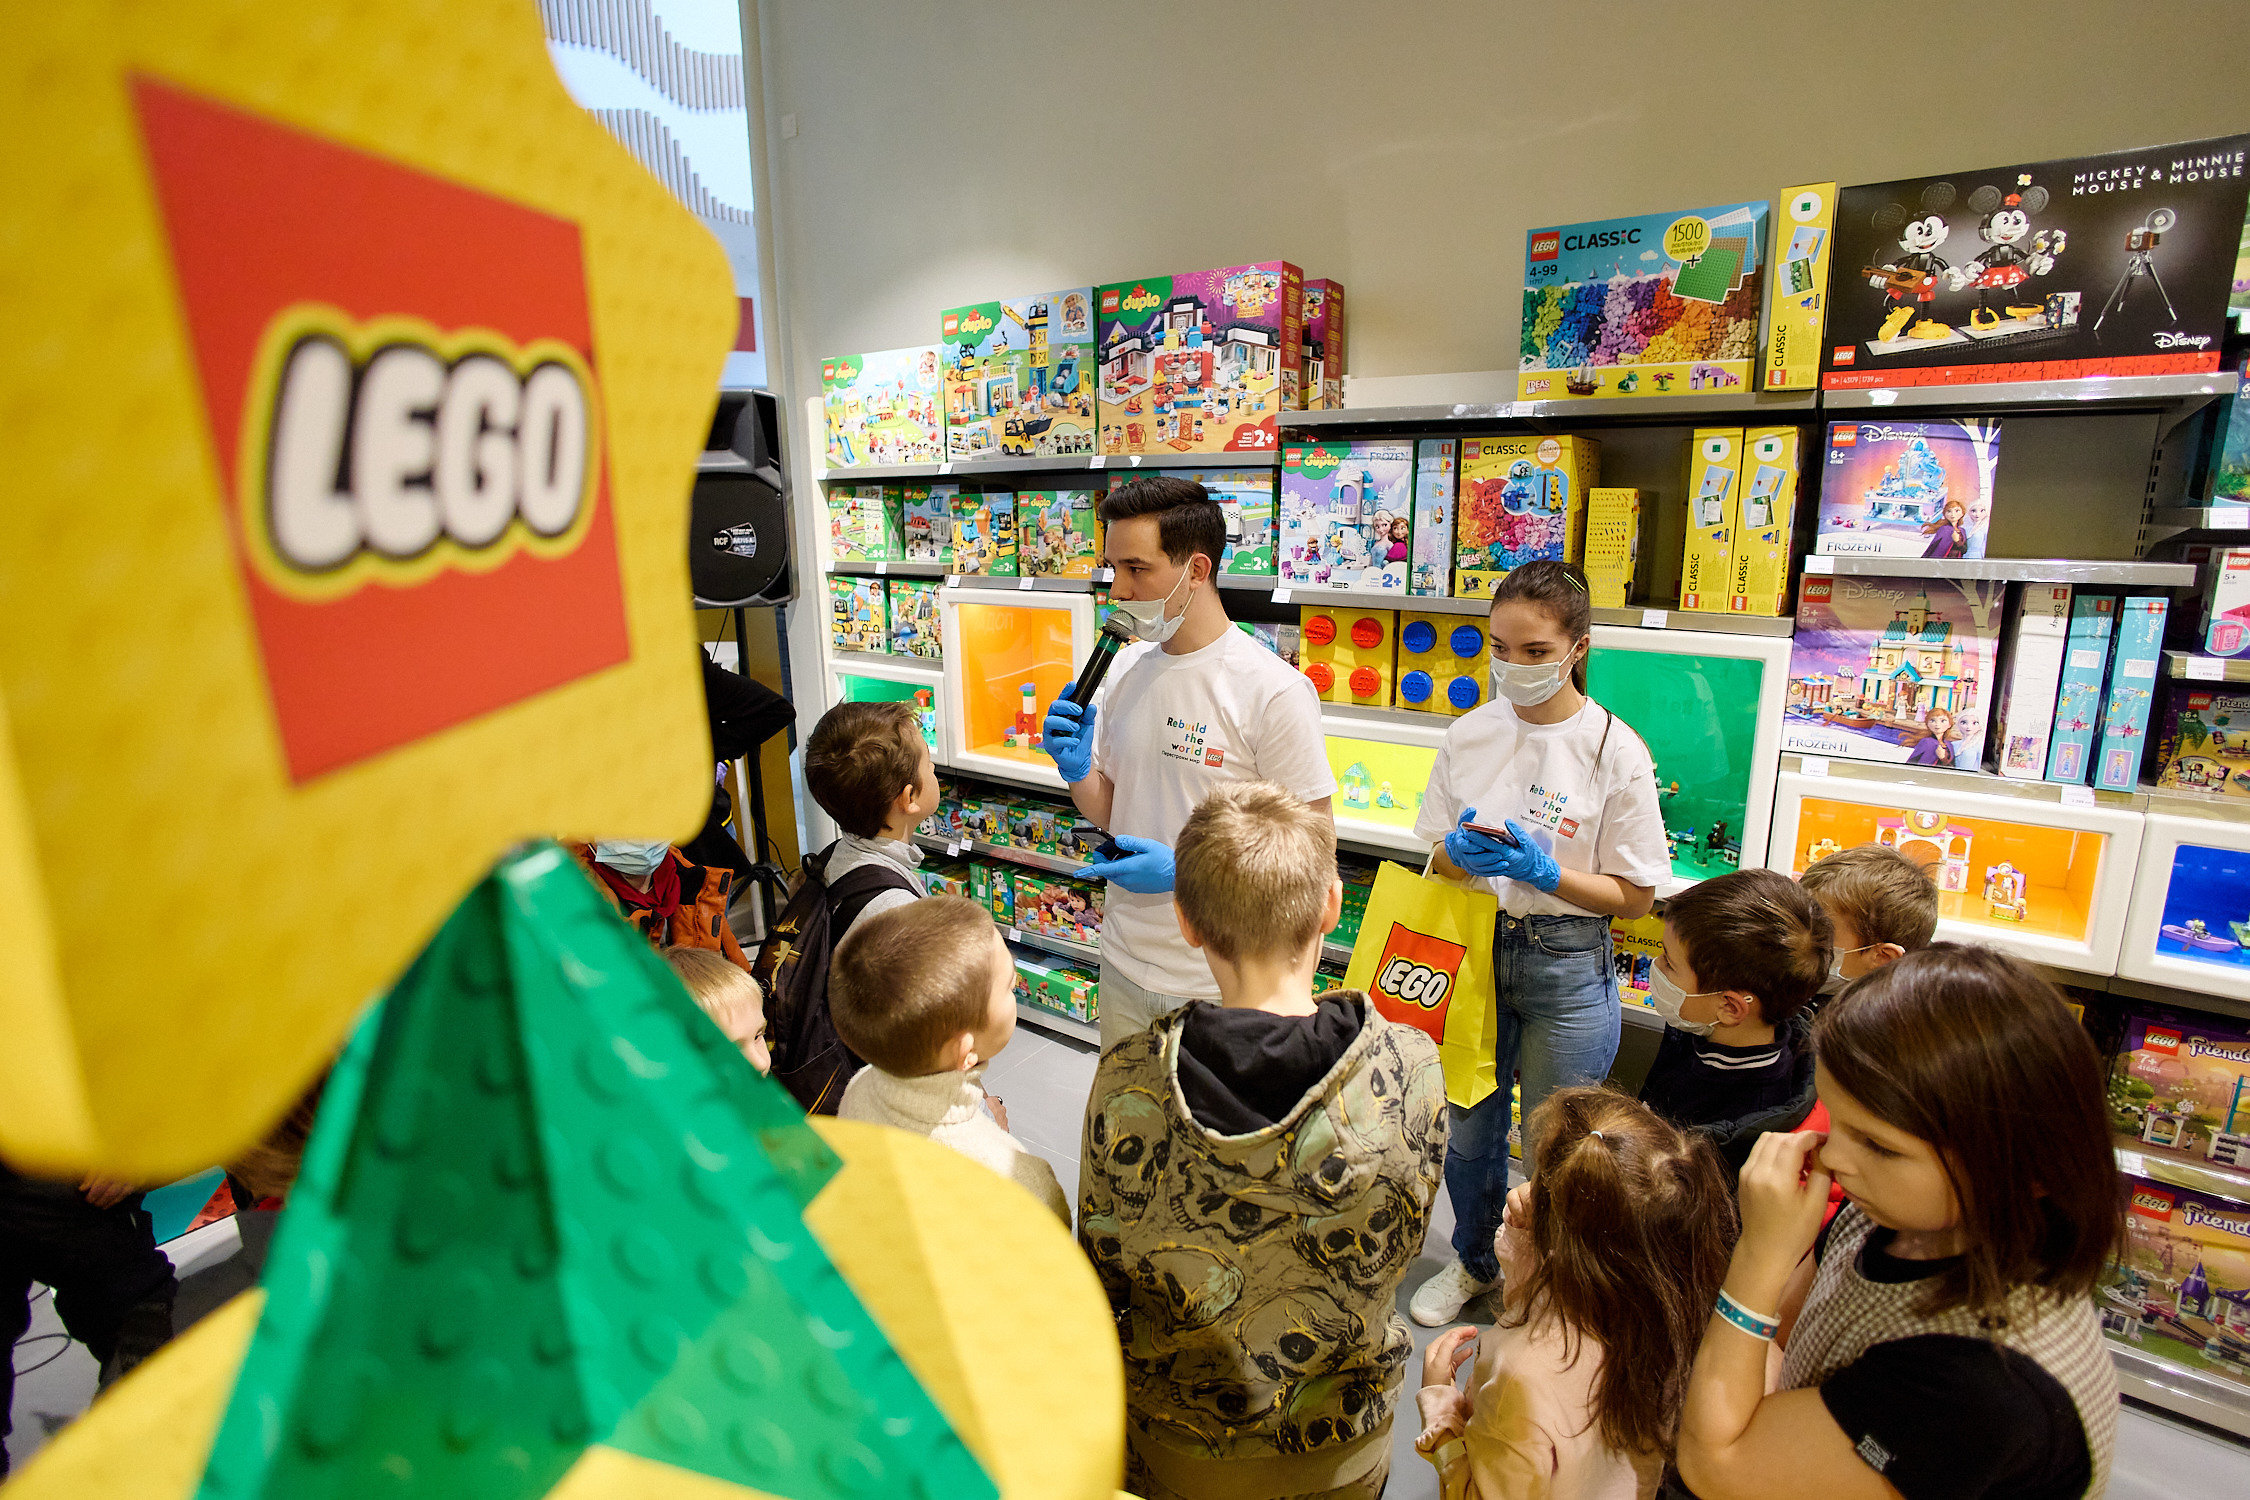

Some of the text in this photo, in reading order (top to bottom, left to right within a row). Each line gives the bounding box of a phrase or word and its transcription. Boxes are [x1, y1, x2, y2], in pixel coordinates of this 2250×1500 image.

[2074, 152, 2245, 184] MICKEY & MINNIE
[2072, 165, 2243, 196] MOUSE MOUSE
[1672, 221, 1704, 242] 1500
[1533, 228, 1642, 252] LEGO CLASSIC
[1529, 264, 1558, 277] 4-99
[1102, 291, 1161, 312] LEGO duplo
[944, 314, 992, 334] LEGO duplo
[2152, 332, 2212, 350] Disney
[1834, 351, 1854, 361] LEGO
[1254, 429, 1275, 448] 2+
[1833, 424, 1919, 446] LEGO Disney
[267, 335, 590, 572] LEGO
[1369, 451, 1409, 462] FROZEN
[1464, 444, 1527, 455] LEGO CLASSIC
[1830, 450, 1845, 459] 6+
[1304, 453, 1340, 469] duplo
[1031, 497, 1051, 508] duplo
[713, 537, 729, 546] RCF
[1826, 541, 1882, 553] FROZEN II
[1004, 562, 1014, 572] 2+
[1252, 556, 1269, 571] 2+
[1381, 573, 1402, 588] 2+
[1805, 578, 1905, 607] LEGO Disney
[1801, 606, 1819, 617] 5+
[1351, 676, 1376, 692] LEGO
[2190, 696, 2210, 705] LEGO
[2184, 711, 2198, 719] 6+
[1166, 716, 1207, 734] Rebuild
[1184, 733, 1204, 745] the
[1787, 736, 1848, 752] FROZEN II
[1171, 743, 1202, 756] world
[1529, 784, 1568, 804] Rebuild
[1542, 800, 1562, 814] the
[1529, 808, 1559, 824] world
[1379, 955, 1449, 1008] LEGO
[2145, 1034, 2178, 1047] LEGO
[2139, 1053, 2158, 1066] 7+
[2132, 1193, 2171, 1212] LEGO
[2126, 1217, 2149, 1231] 8+
